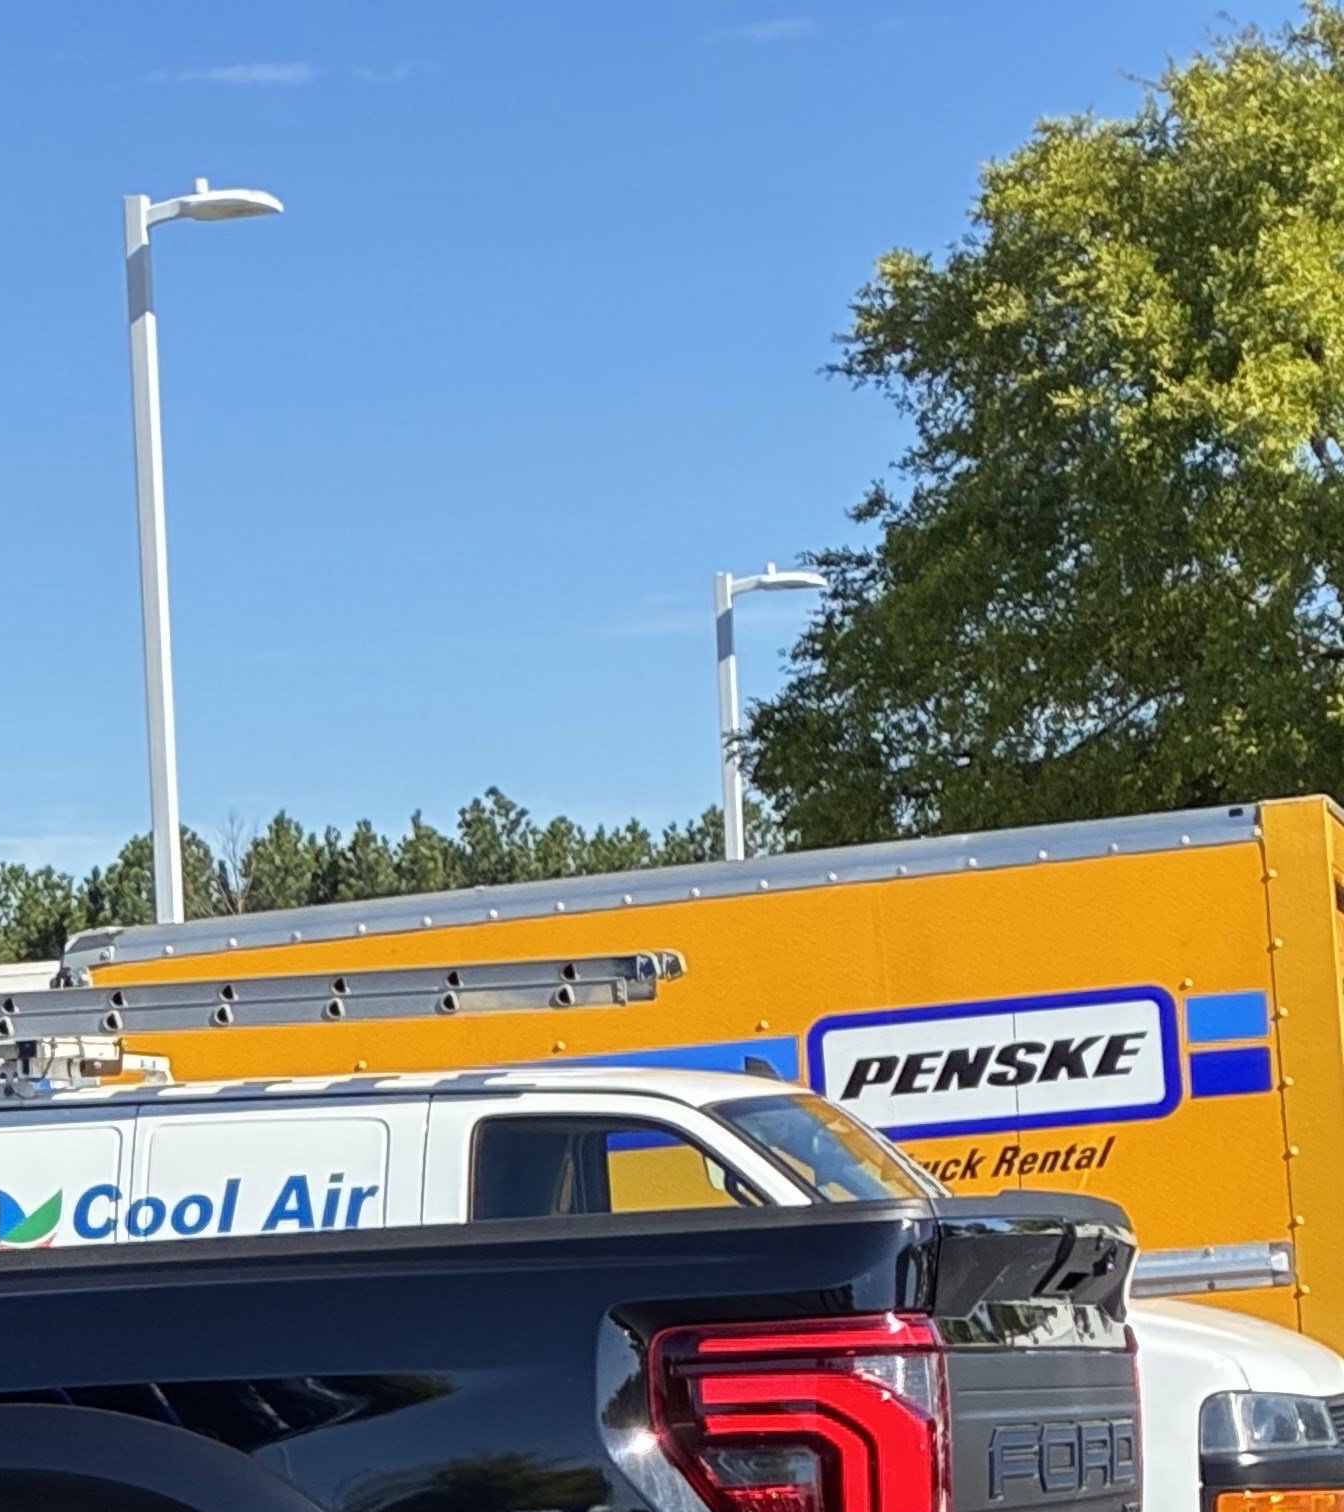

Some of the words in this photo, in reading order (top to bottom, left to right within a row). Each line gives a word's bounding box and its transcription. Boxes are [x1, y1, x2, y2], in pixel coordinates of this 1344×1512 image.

[839, 1031, 1148, 1101] PENSKE
[909, 1148, 988, 1182] uck
[991, 1136, 1116, 1178] Rental
[73, 1177, 242, 1240] Cool
[260, 1171, 380, 1229] Air
[988, 1417, 1135, 1500] FORD
